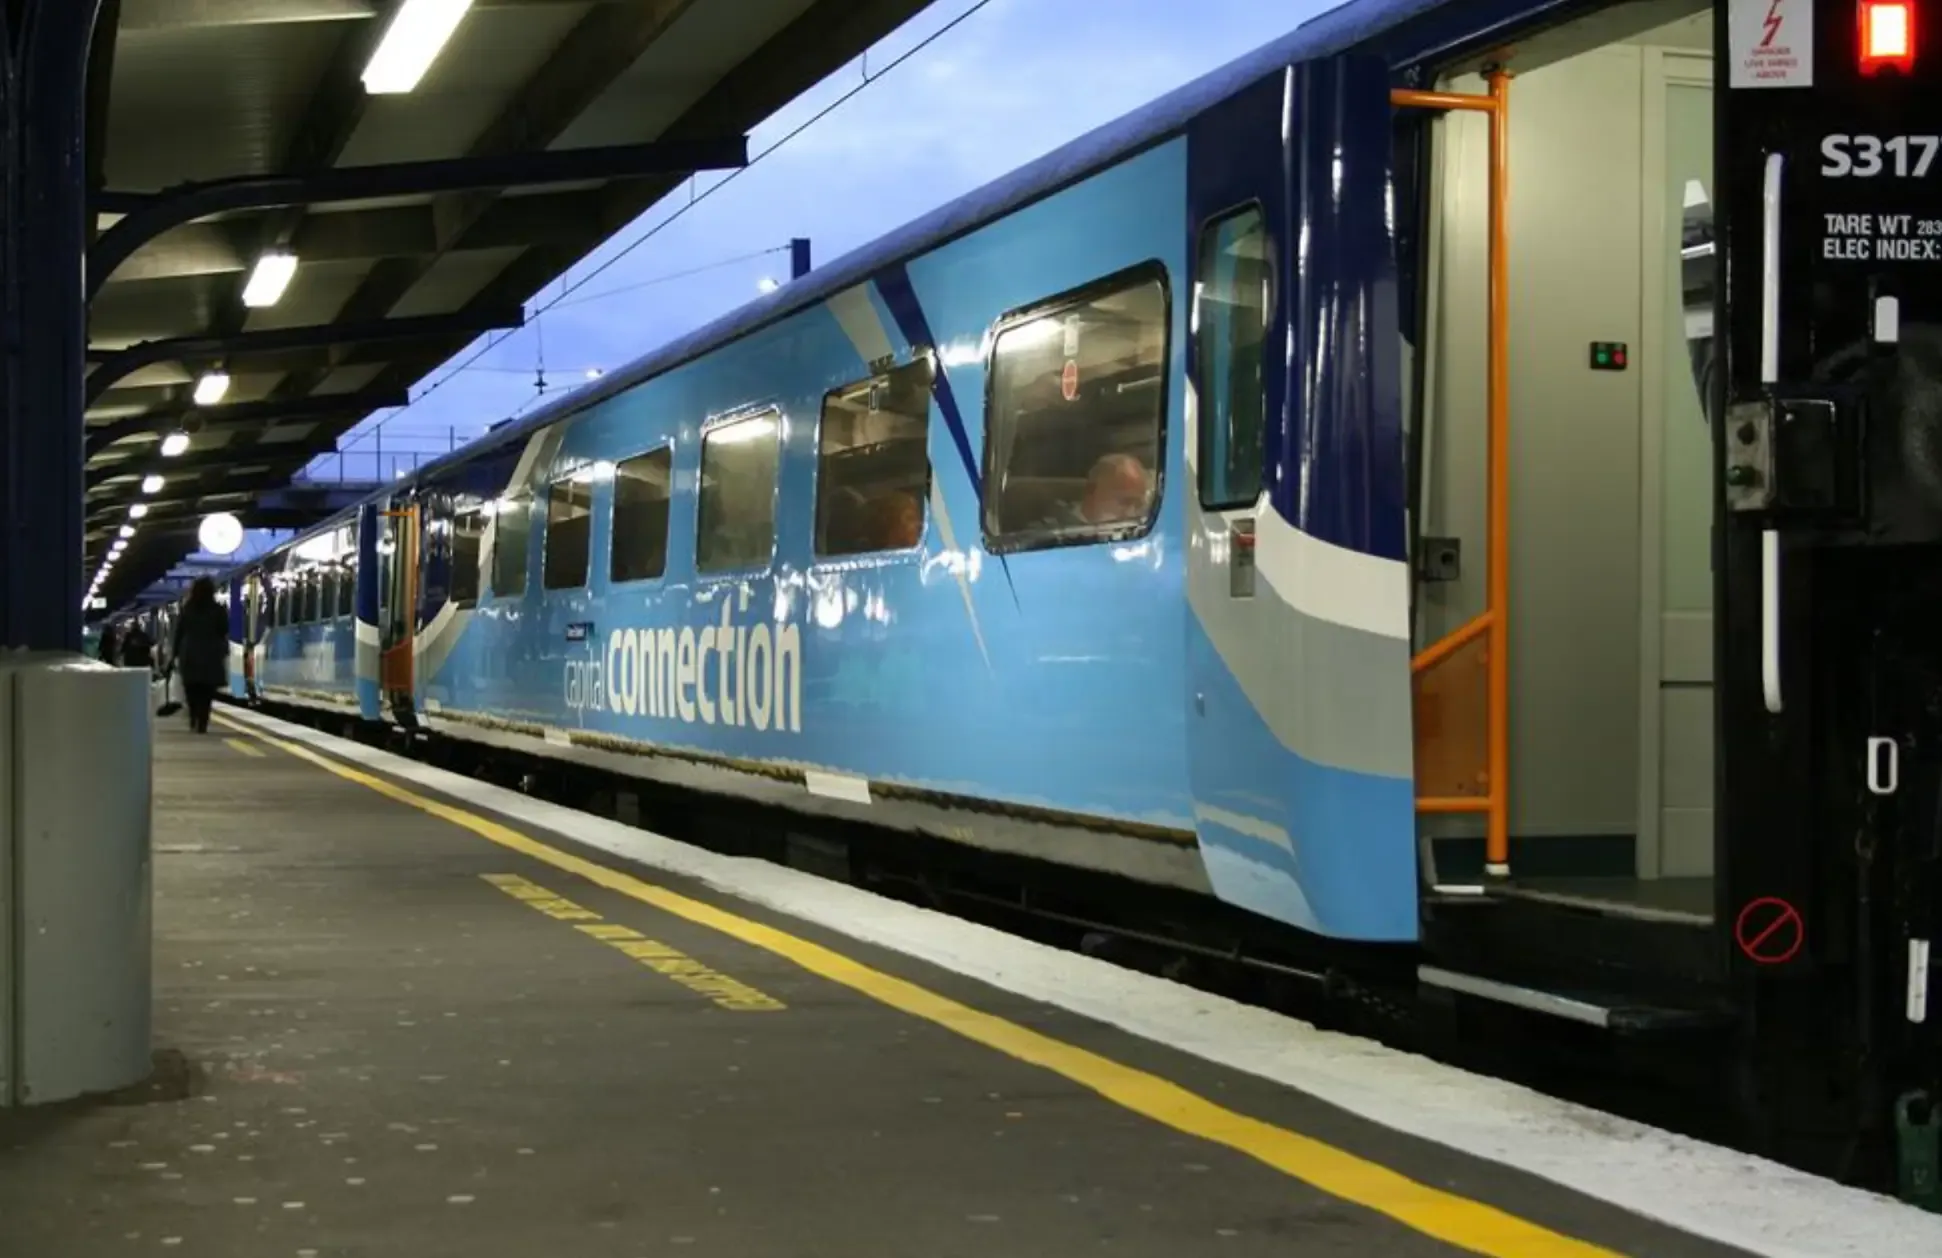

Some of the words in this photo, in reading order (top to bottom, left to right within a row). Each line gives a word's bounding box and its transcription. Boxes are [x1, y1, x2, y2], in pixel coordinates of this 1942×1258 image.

[1821, 134, 1942, 177] S317
[1824, 214, 1871, 235] TARE
[1878, 214, 1911, 235] WT
[1823, 239, 1870, 259] ELEC
[1876, 239, 1941, 259] INDEX:
[564, 642, 605, 728] capital
[608, 582, 800, 732] connection
